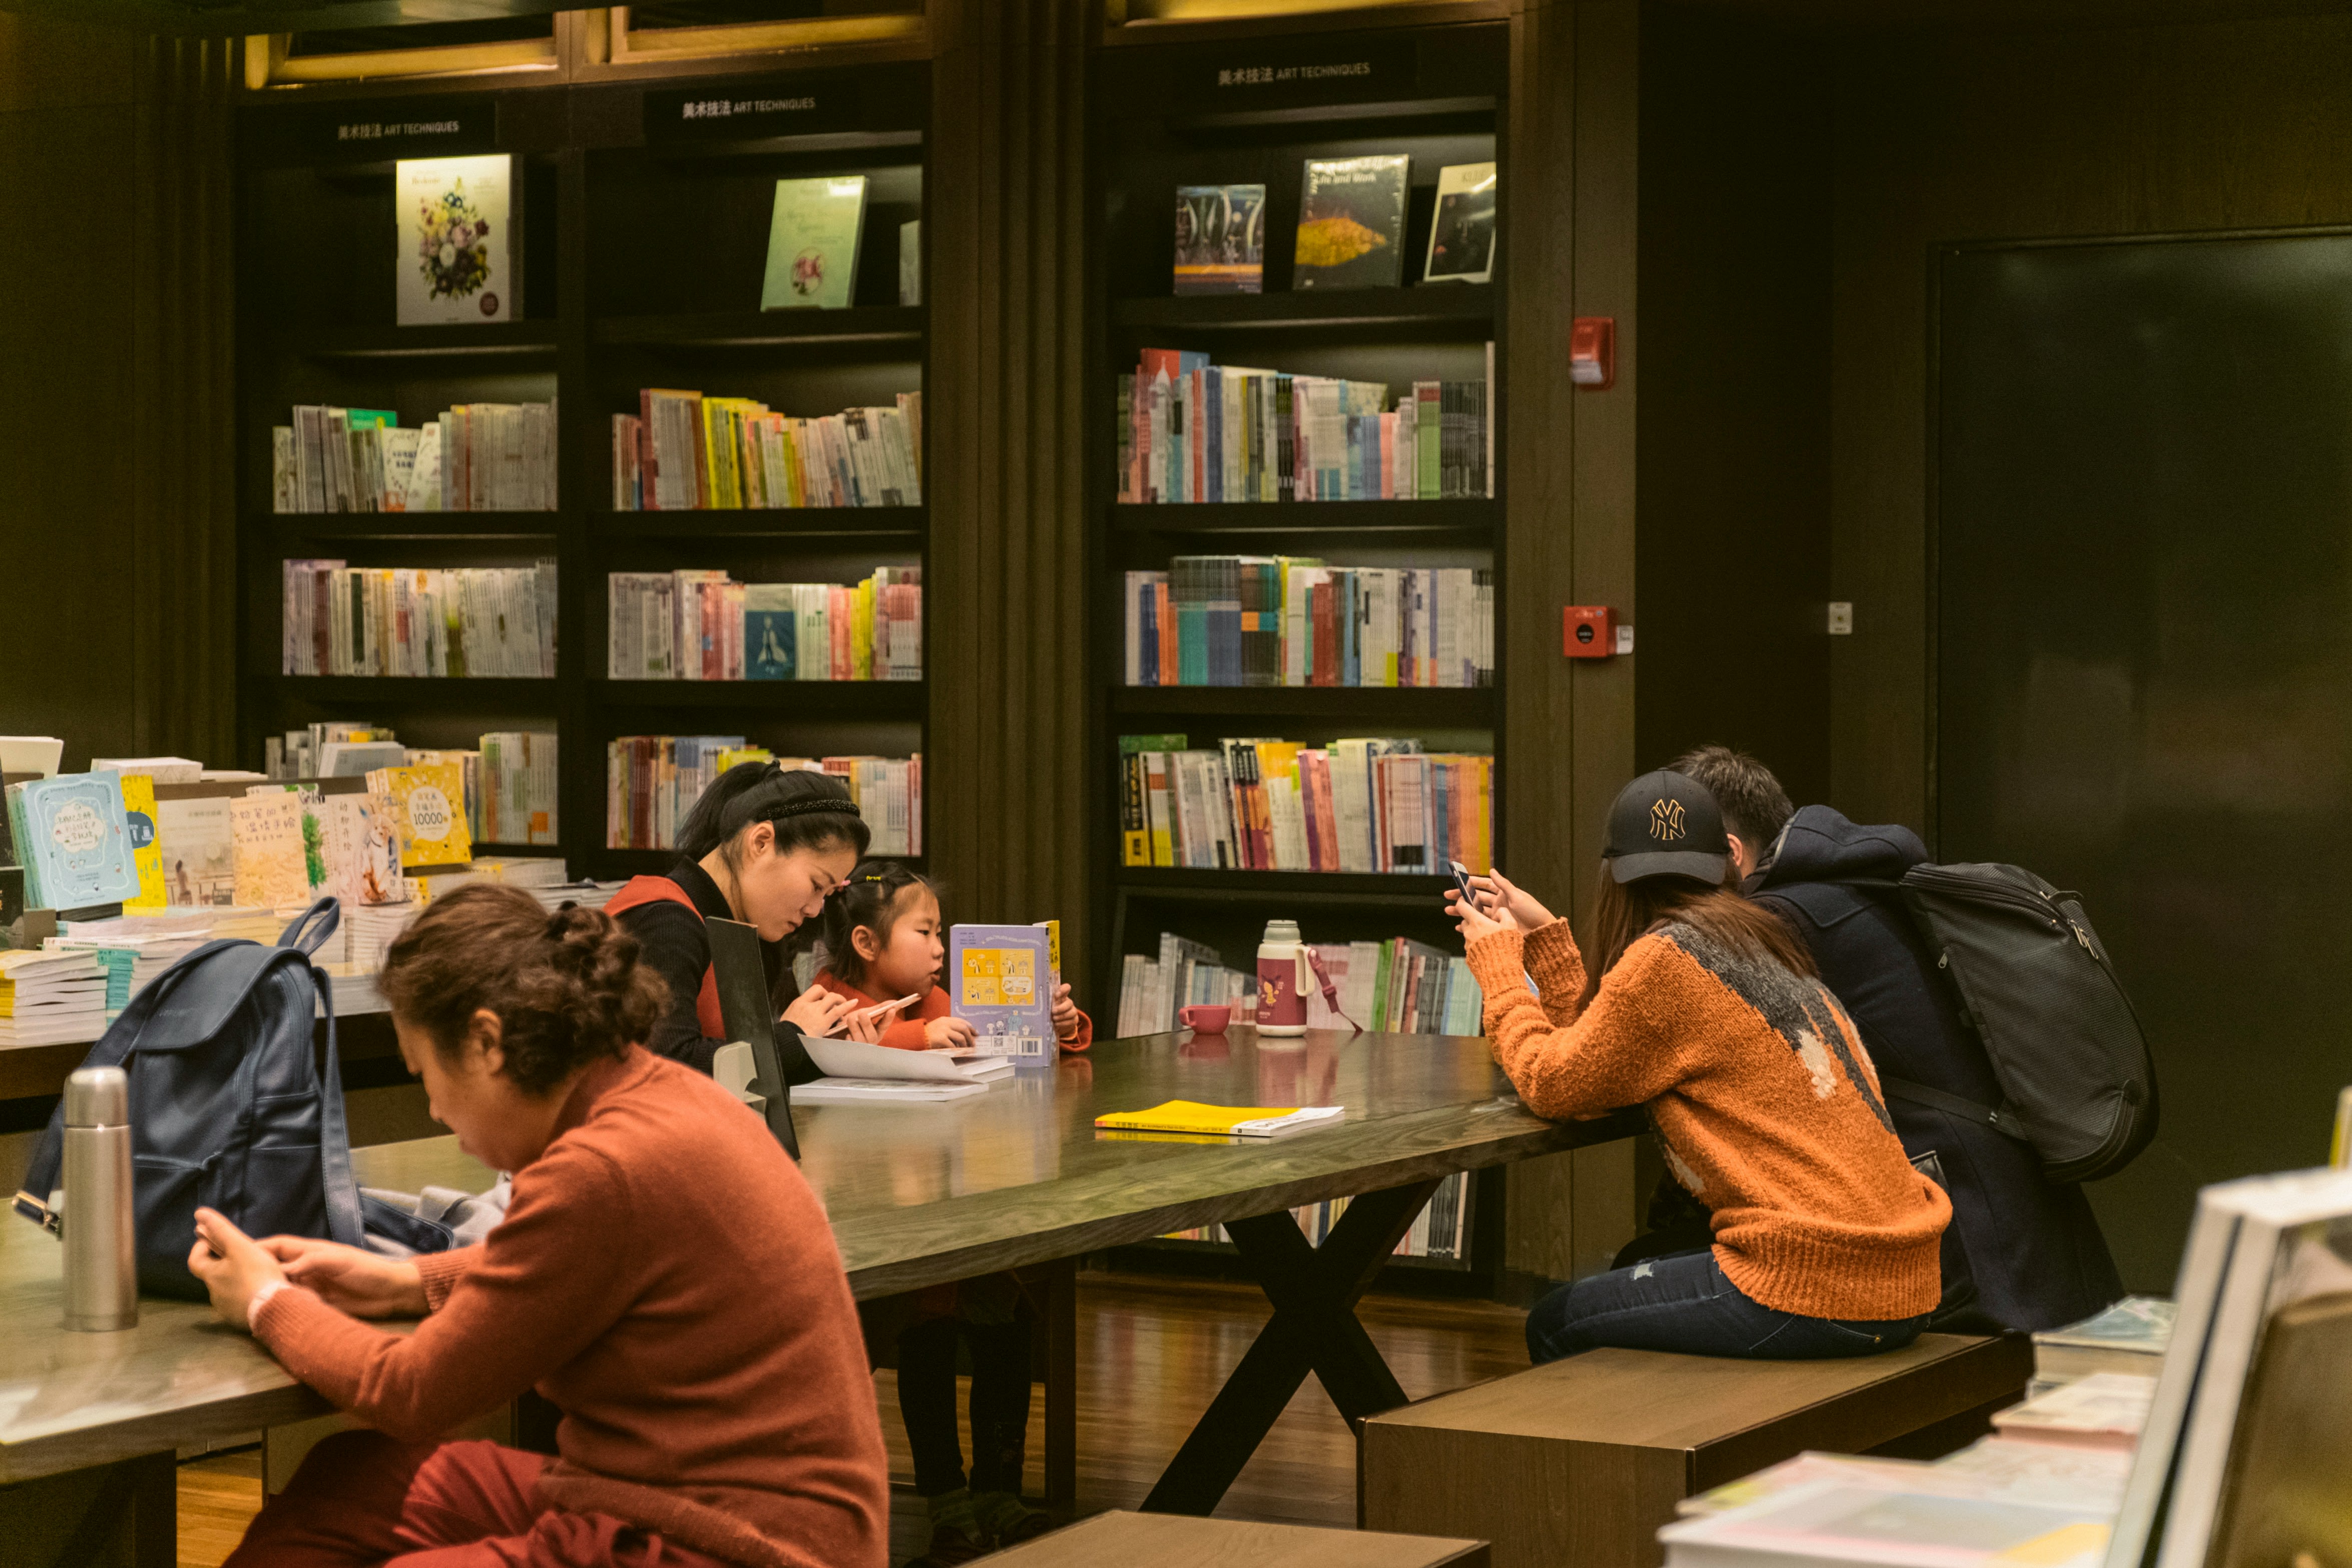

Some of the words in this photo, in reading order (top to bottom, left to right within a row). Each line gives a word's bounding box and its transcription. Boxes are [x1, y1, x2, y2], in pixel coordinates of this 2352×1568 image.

[1276, 68, 1297, 80] ART
[1300, 63, 1370, 78] TECHNIQUES
[683, 100, 731, 119] 美术技法
[733, 102, 751, 113] ART
[754, 98, 816, 112] TECHNIQUES
[384, 125, 400, 136] ART
[403, 121, 459, 135] TECHNIQUES
[1650, 798, 1686, 840] NY
